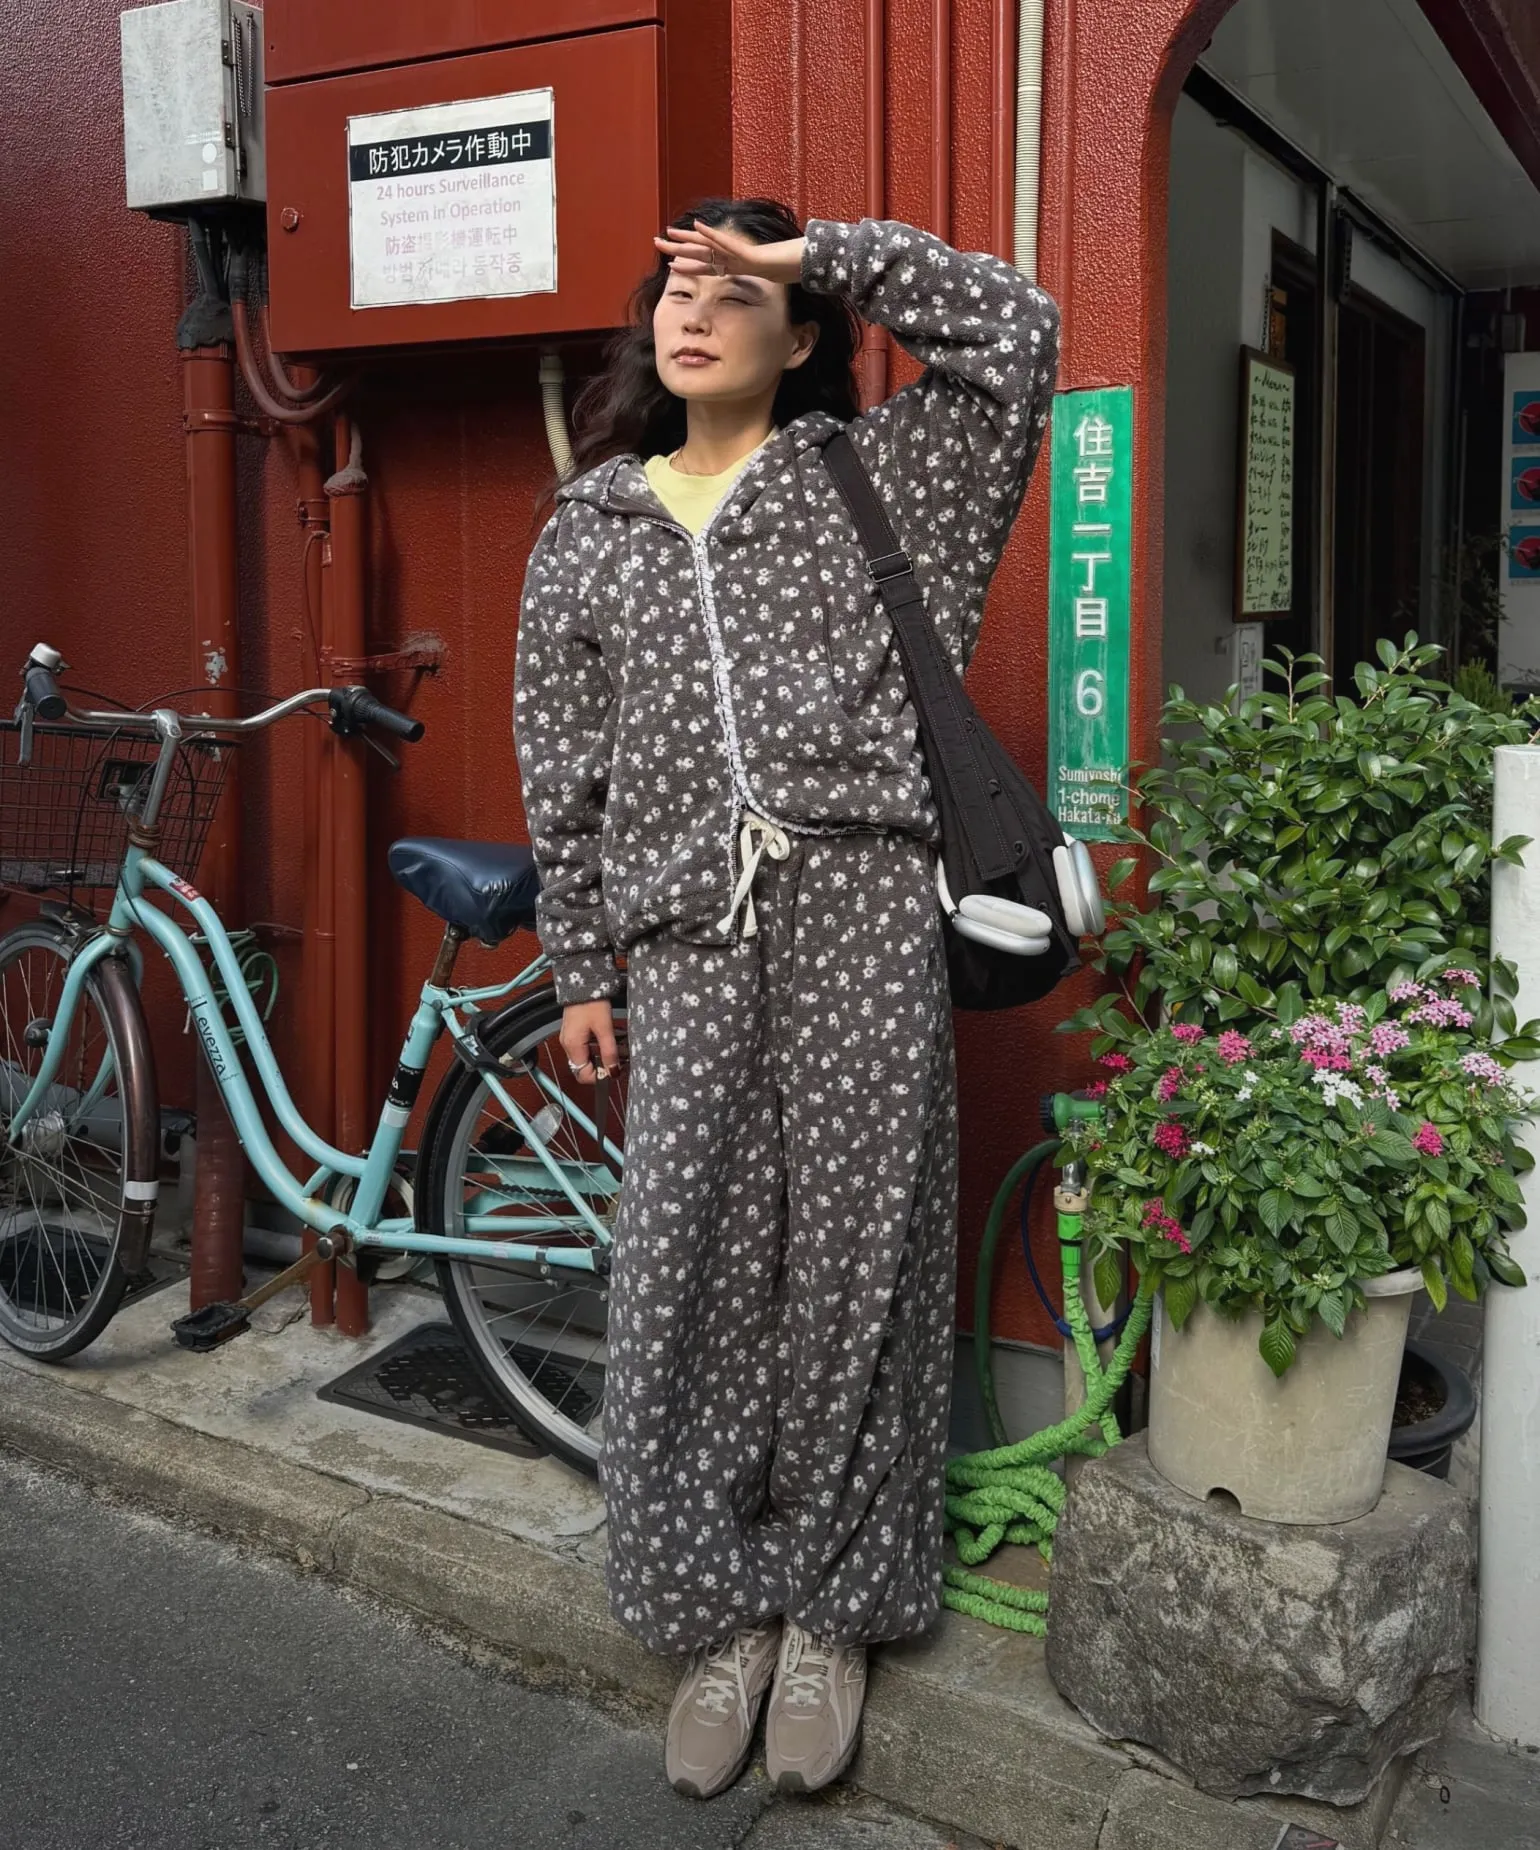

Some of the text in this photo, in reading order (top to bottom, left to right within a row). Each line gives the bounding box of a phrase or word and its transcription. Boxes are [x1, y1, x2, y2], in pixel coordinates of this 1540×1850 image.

[369, 129, 532, 175] 防犯カメラ作動中
[376, 171, 525, 201] 24 hours Surveillance
[380, 198, 521, 228] System in Operation
[472, 252, 522, 276] 동작중
[1072, 416, 1113, 716] 住吉一丁目 6
[1058, 765, 1122, 783] Sumiyoshi
[1058, 787, 1121, 806] 1-chome
